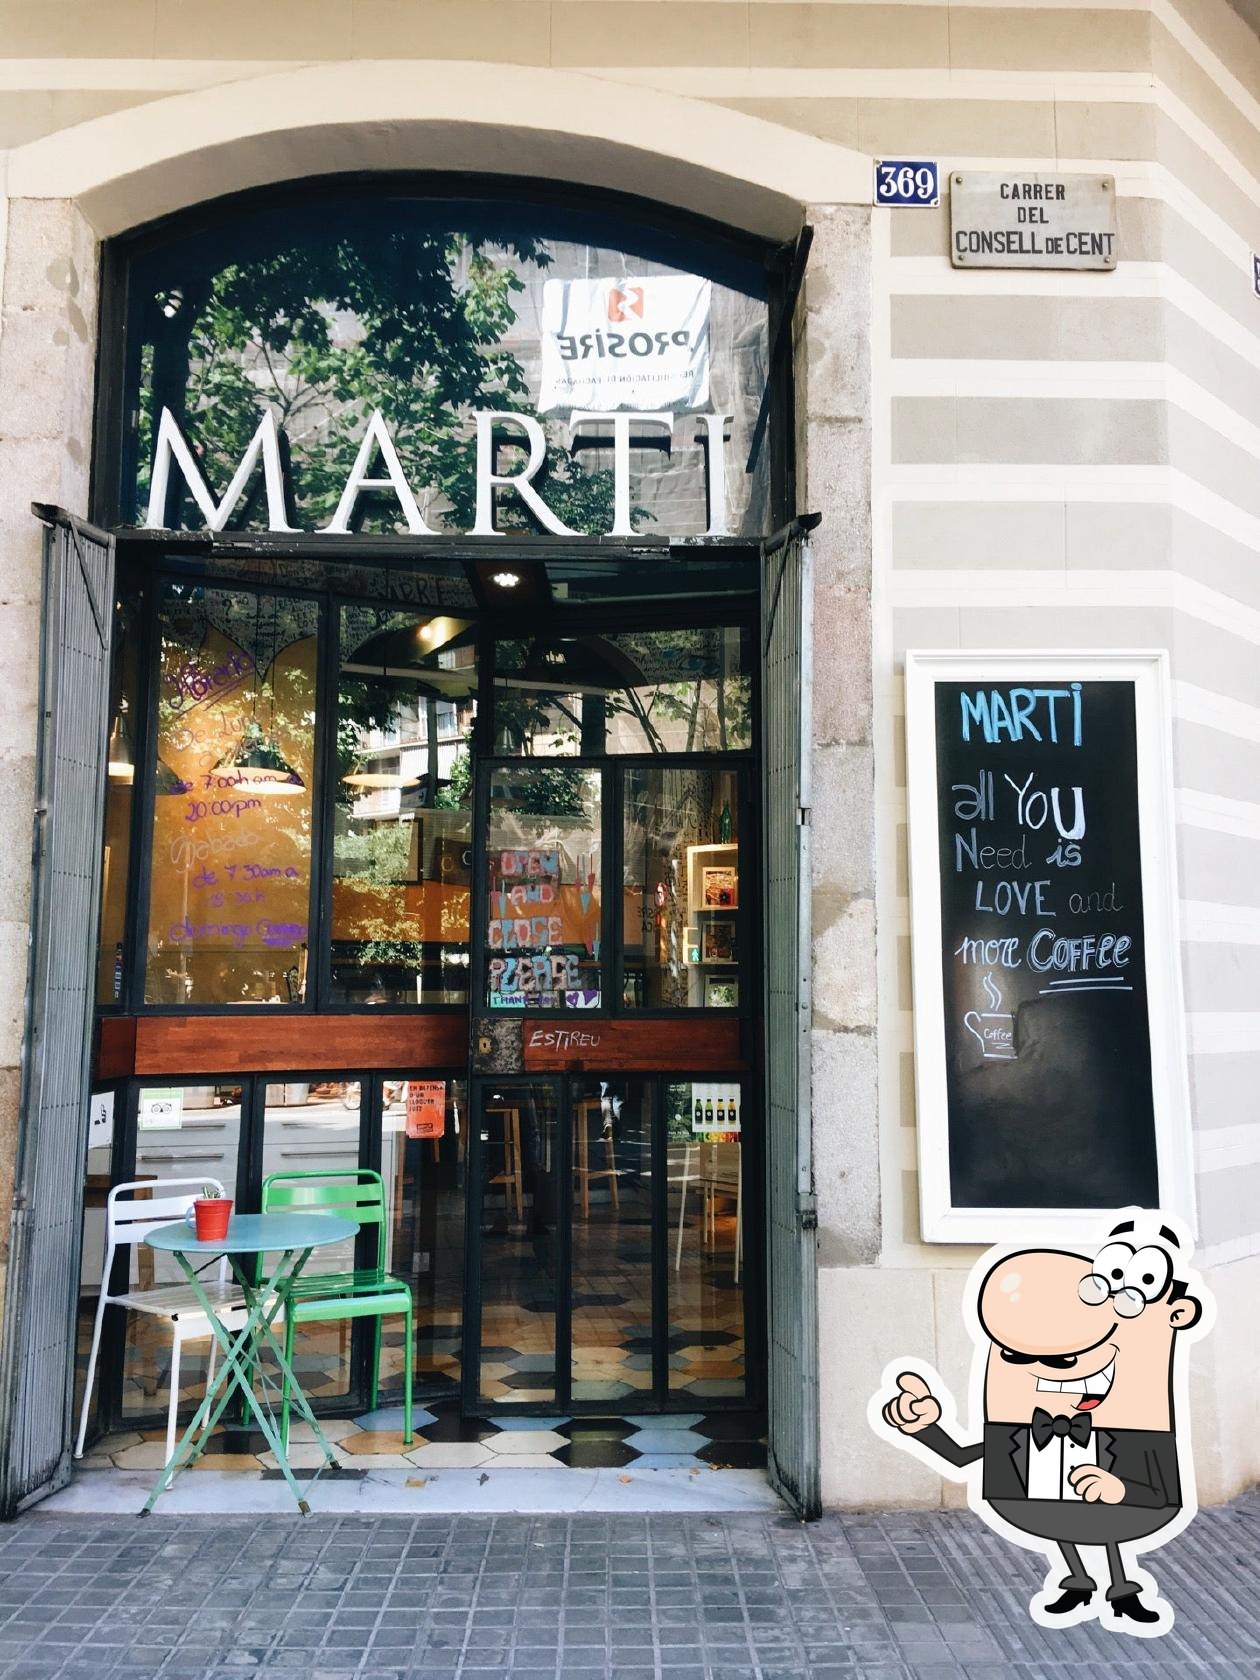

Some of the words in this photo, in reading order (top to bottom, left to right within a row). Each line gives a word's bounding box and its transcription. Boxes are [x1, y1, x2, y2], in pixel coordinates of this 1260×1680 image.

[878, 166, 935, 198] 369
[1000, 183, 1066, 201] CARRER
[1016, 206, 1050, 225] DEL
[955, 230, 1044, 255] CONSELL
[1065, 231, 1116, 256] CENT
[141, 405, 734, 537] MARTI
[955, 827, 1033, 872] Need
[1045, 838, 1082, 868] is
[975, 880, 1056, 916] LOVE
[1068, 882, 1124, 914] and
[953, 936, 1022, 968] more
[488, 954, 582, 991] PLEASE
[983, 1028, 1013, 1041] Coffee
